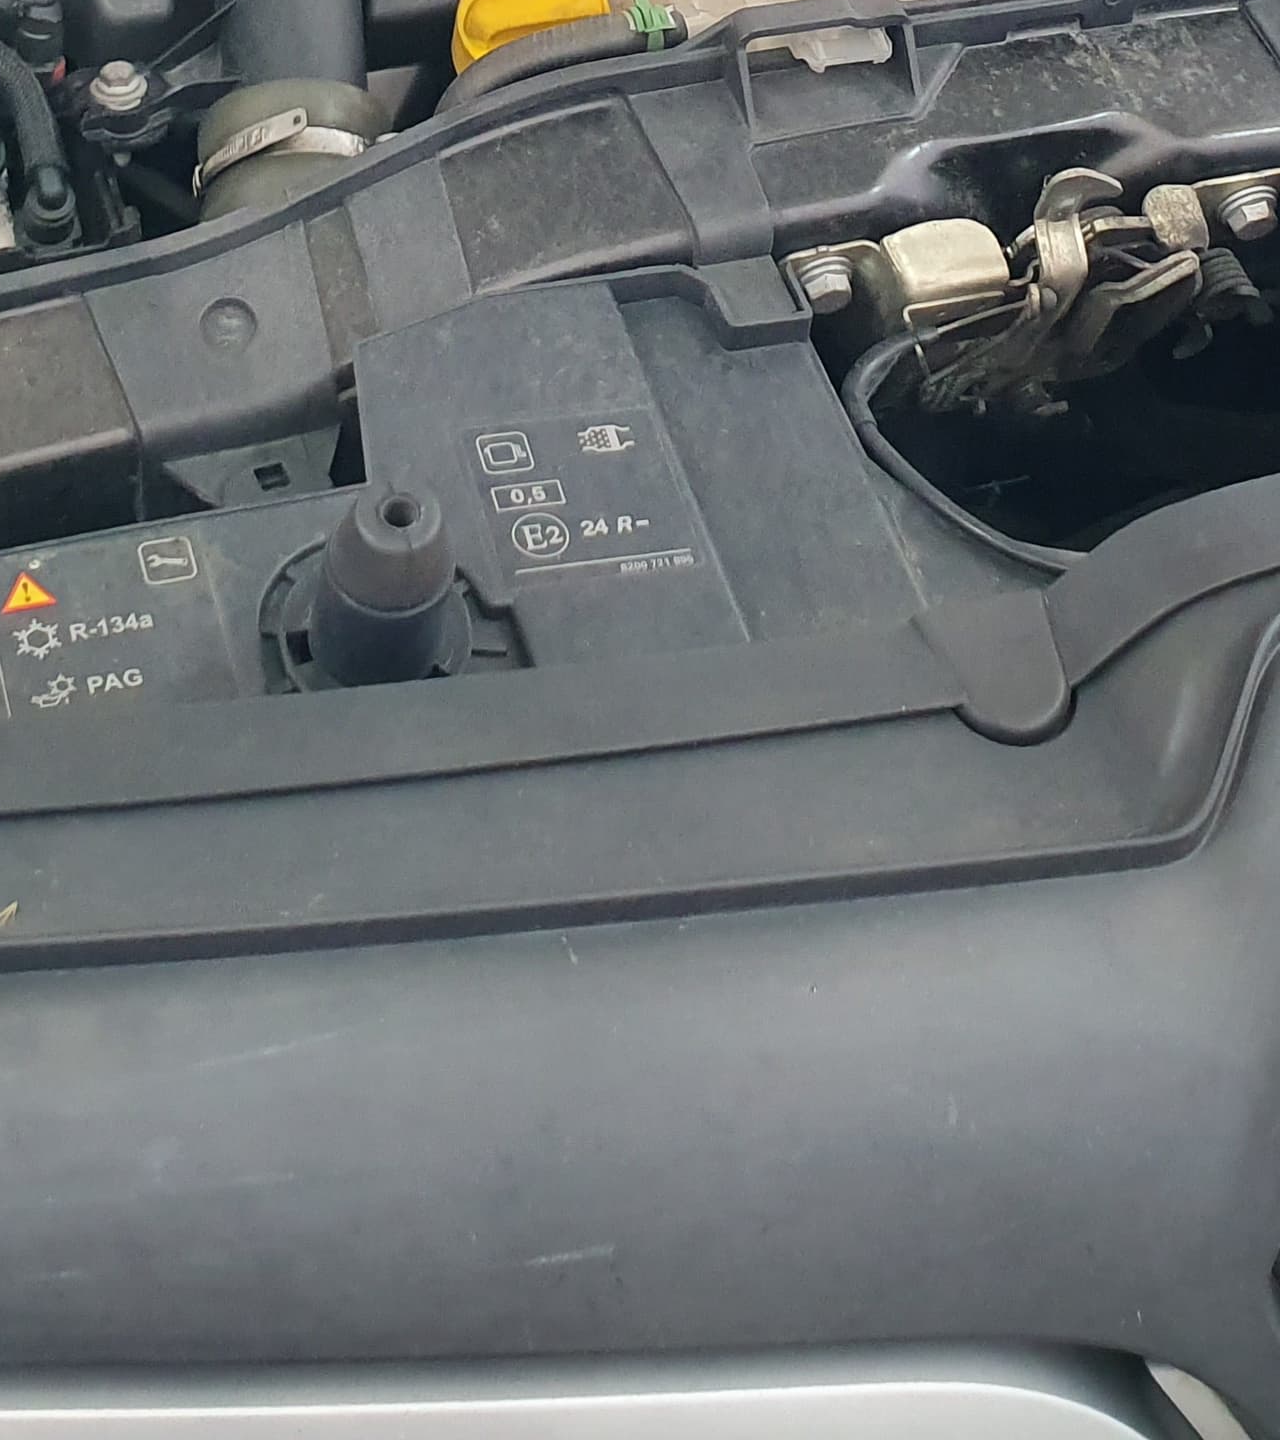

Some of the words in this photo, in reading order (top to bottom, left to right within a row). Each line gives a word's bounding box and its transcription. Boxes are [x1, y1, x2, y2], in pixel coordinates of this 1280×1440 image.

[509, 486, 547, 506] 0,5
[522, 524, 564, 550] E2
[580, 516, 609, 537] 24
[70, 612, 154, 642] R-134a
[86, 668, 144, 695] PAG
